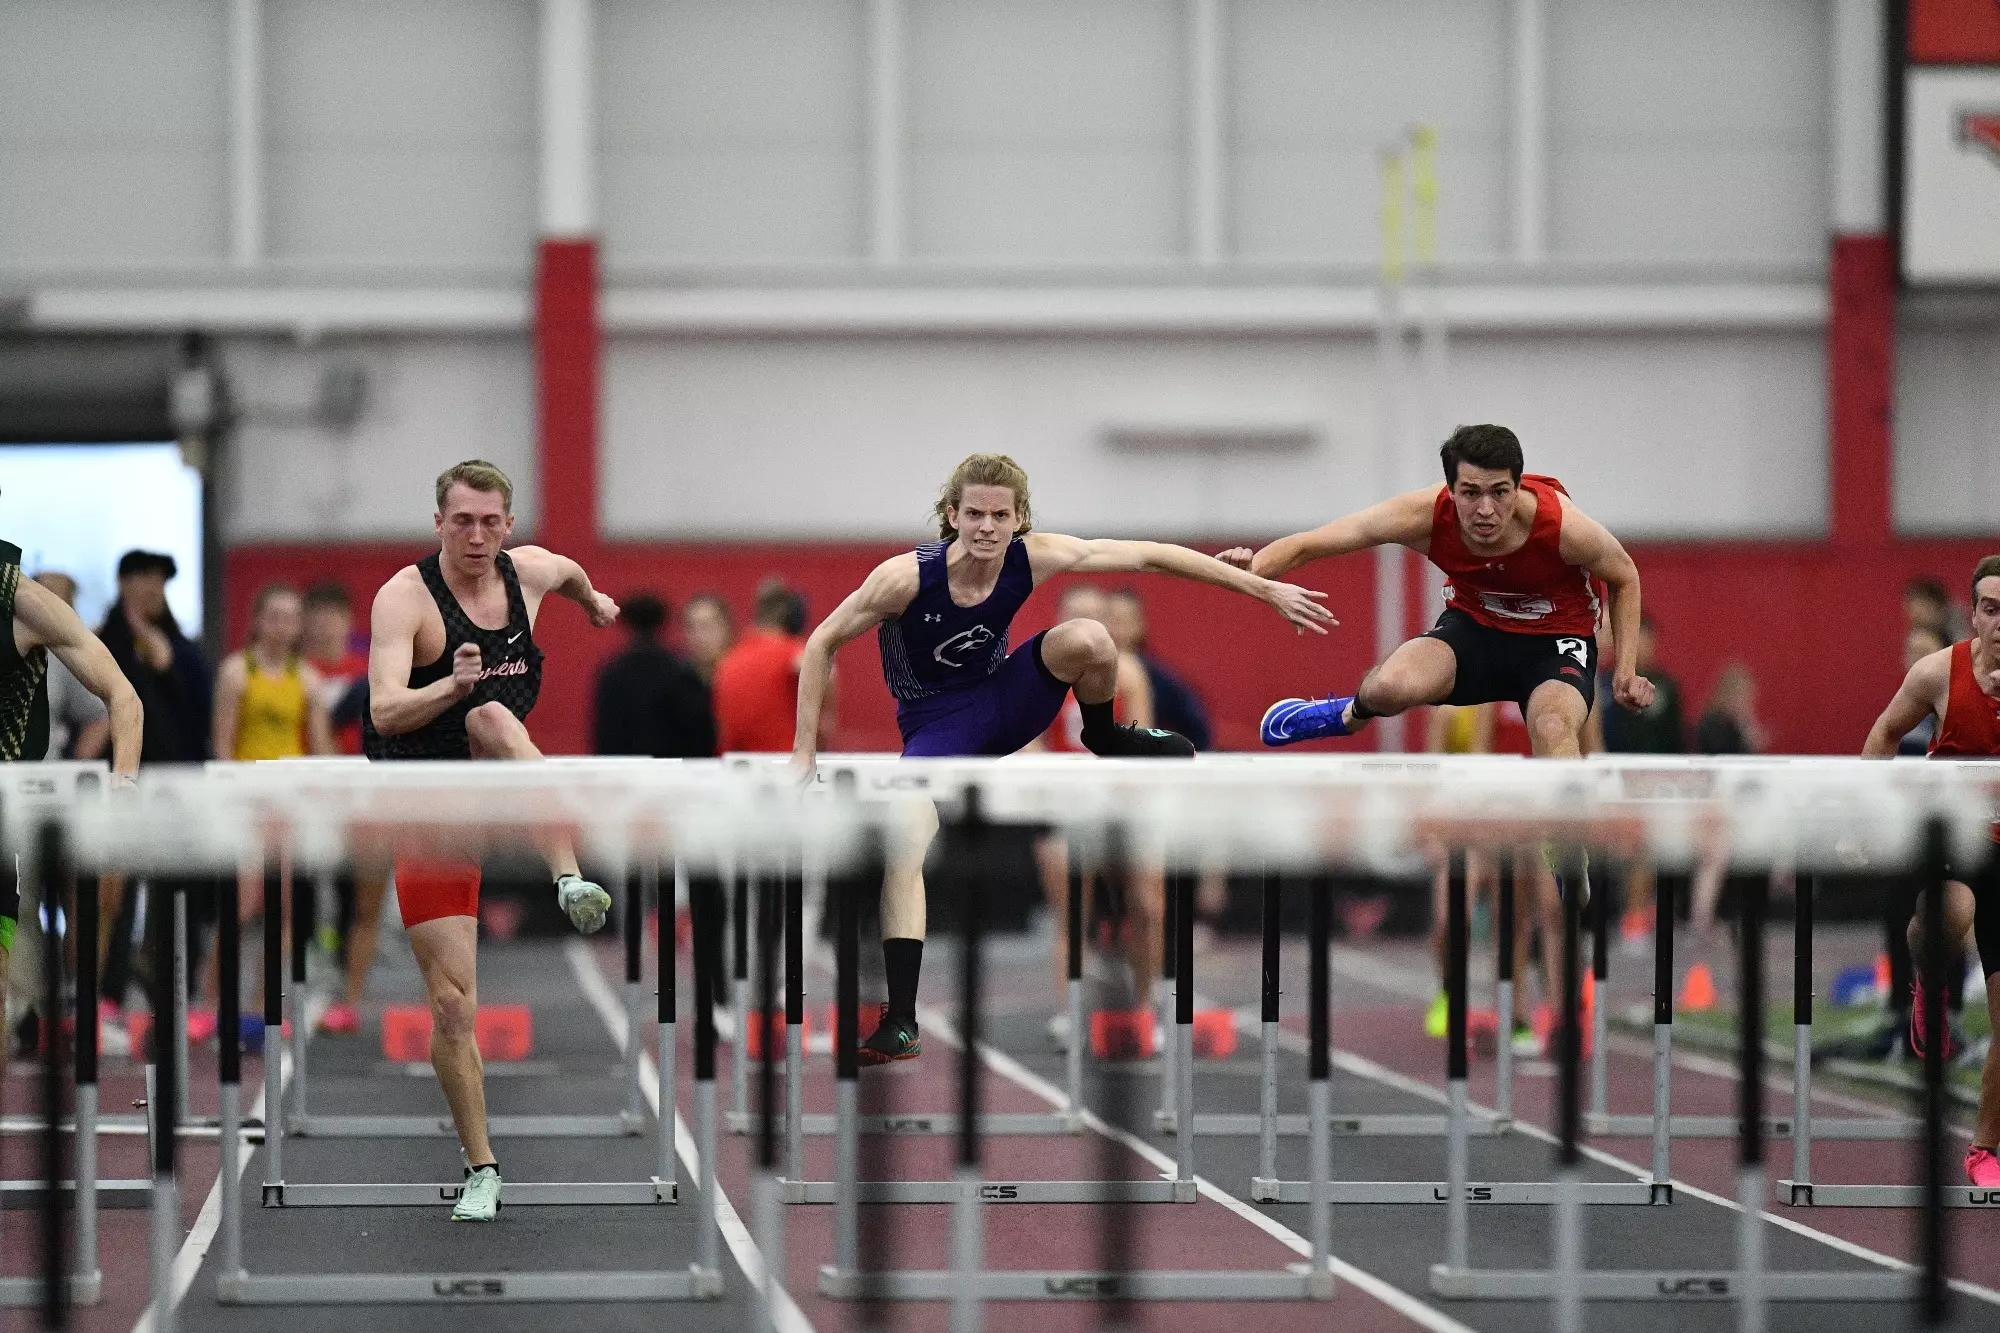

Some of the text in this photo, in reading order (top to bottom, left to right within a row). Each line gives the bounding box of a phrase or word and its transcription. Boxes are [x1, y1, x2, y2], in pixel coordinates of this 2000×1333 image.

[977, 1185, 1018, 1199] CS
[1969, 1191, 2000, 1204] UC
[432, 1280, 504, 1296] UCS
[1658, 1278, 1730, 1295] UCS
